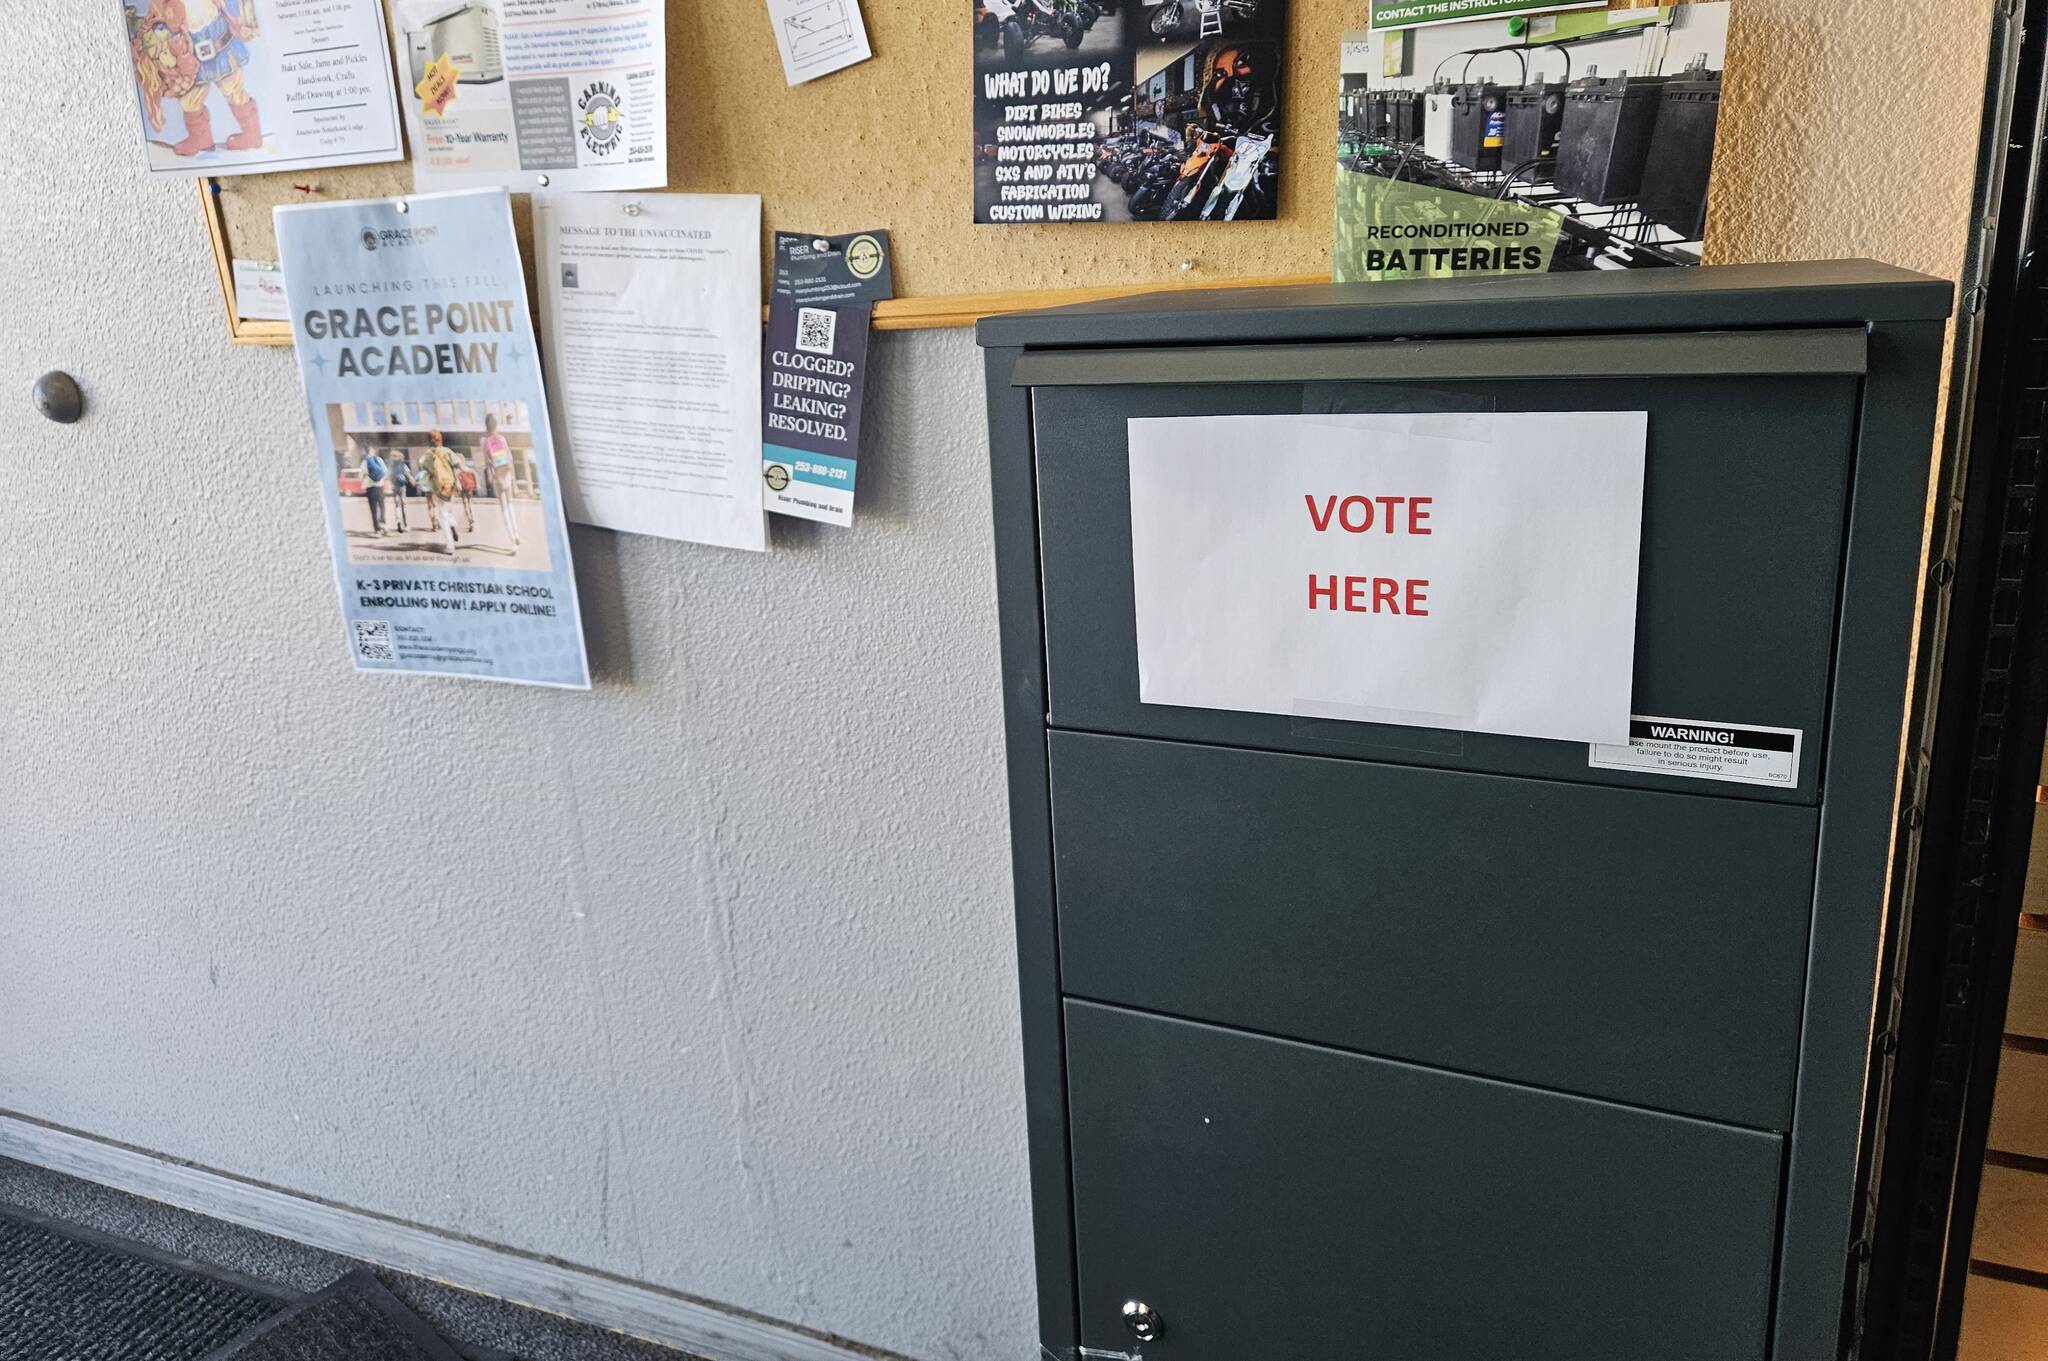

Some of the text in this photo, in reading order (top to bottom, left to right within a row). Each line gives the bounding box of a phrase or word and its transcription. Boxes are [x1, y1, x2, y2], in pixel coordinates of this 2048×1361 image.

[1376, 7, 1425, 21] CONTACT
[1427, 3, 1449, 14] THE
[281, 63, 297, 73] Bake
[332, 57, 344, 66] and
[346, 54, 368, 64] Pickles
[336, 71, 356, 81] Crafts
[984, 62, 1111, 99] WHAT DO WE DO?
[286, 91, 306, 102] Raffle
[307, 89, 335, 99] Drawing
[1005, 102, 1082, 122] DIRT BIKES
[473, 131, 509, 144] Warranty
[580, 123, 622, 157] ELECTRIC
[997, 122, 1095, 142] SNOWMOBILES
[998, 143, 1094, 161] MOTORCYCLES
[995, 163, 1096, 182] SXS AND ATV'S
[1001, 184, 1090, 201] FABRICATION
[989, 203, 1101, 220] CUSTOM WIRING
[380, 228, 413, 240] GRACE
[560, 226, 712, 240] MESSAGE TO THE UNVACCINATED
[1367, 222, 1530, 240] RECONDITIONED
[789, 245, 809, 255] RISER
[1366, 246, 1542, 271] BATTERIES
[312, 279, 413, 297] LAUNCHING
[423, 277, 457, 291] THIS
[304, 300, 514, 340] GRACE POINT
[337, 342, 499, 378] ACADEMY
[772, 350, 854, 378] CLOGGED?
[772, 372, 851, 399] DRIPPING?
[773, 393, 847, 420] LEAKING?
[768, 413, 848, 441] RESOLVED.
[793, 498, 817, 509] Plumbing
[1304, 494, 1433, 535] VOTE
[356, 579, 555, 599] K-3 PRIVATE CHRISTIAN SCHOOL
[1308, 574, 1430, 617] HERE
[360, 596, 557, 617] ENROLLING NOW! APPLY ONLINE!
[1650, 725, 1735, 745] WARNING!
[1636, 747, 1748, 766] failure to do so might result
[1646, 741, 1672, 751] mount
[1674, 743, 1687, 752] the
[1689, 745, 1721, 756] product
[1722, 748, 1750, 757] before
[1752, 752, 1771, 761] use,
[1667, 759, 1698, 769] serious
[1699, 762, 1723, 772] injury.
